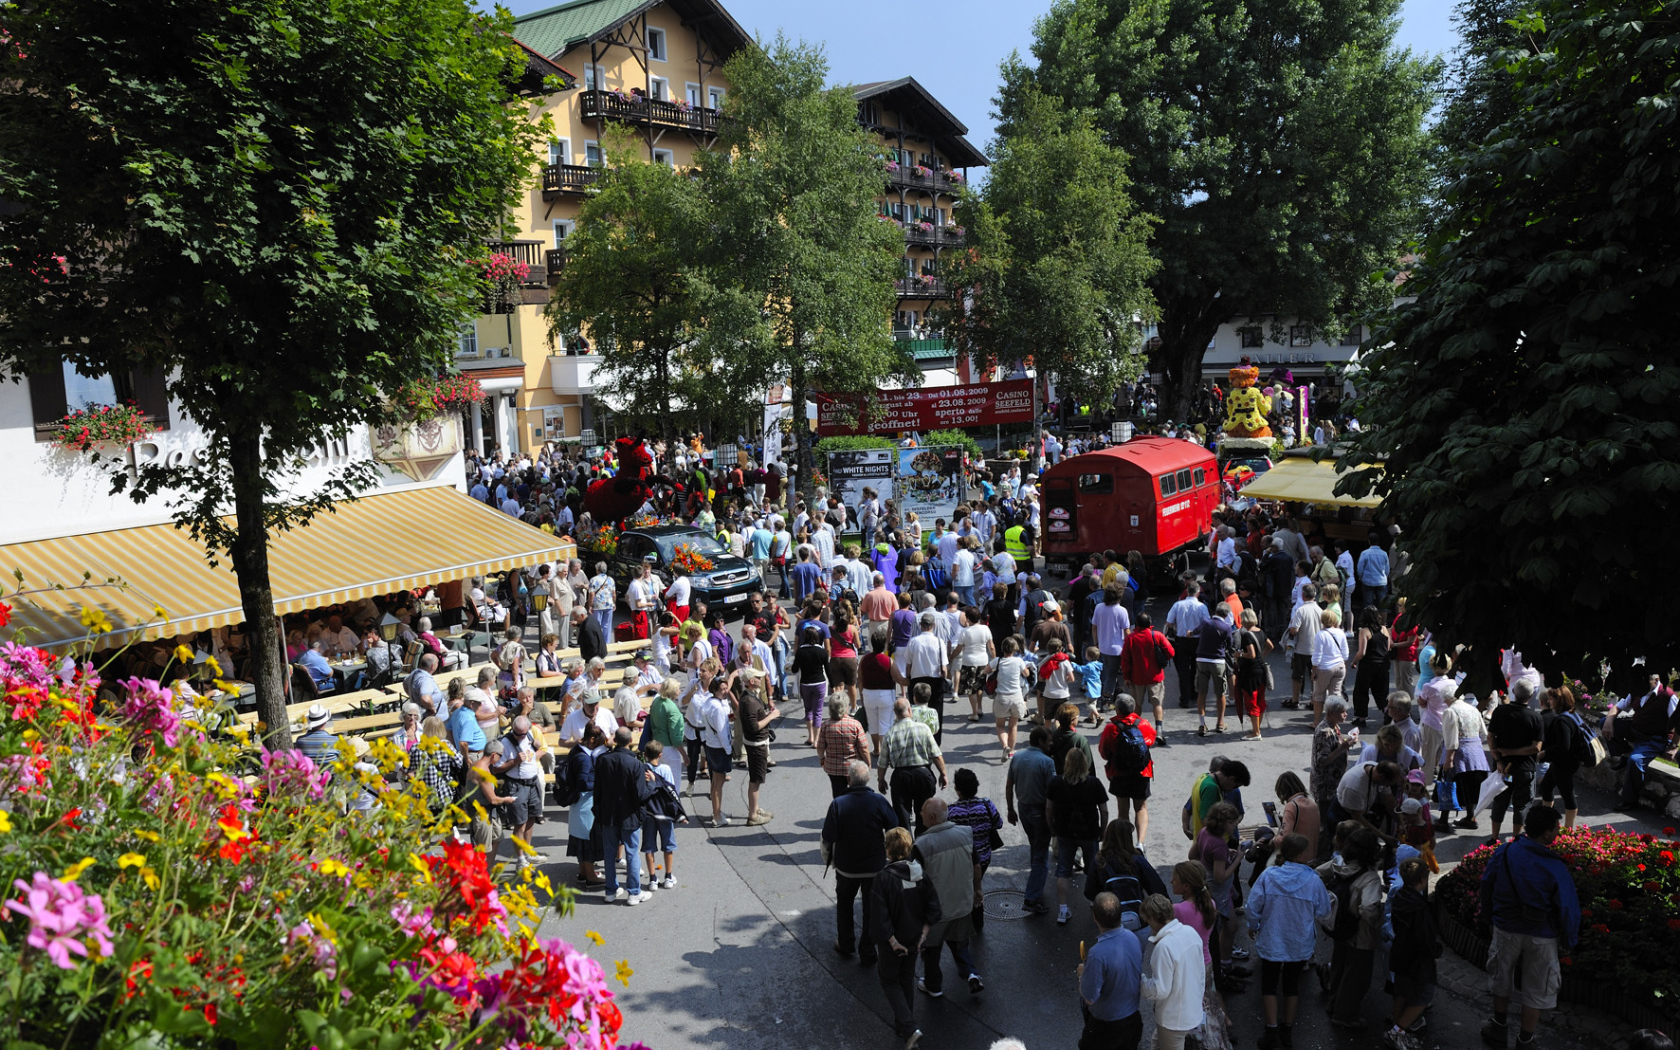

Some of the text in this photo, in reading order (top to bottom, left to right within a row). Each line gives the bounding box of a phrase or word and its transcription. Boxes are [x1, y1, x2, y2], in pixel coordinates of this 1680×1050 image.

[1240, 353, 1315, 364] AILER
[906, 391, 923, 400] 23.
[940, 387, 988, 398] 01.08.2009
[996, 390, 1029, 400] CASINO
[938, 398, 986, 408] 23.08.2009
[995, 399, 1031, 408] SEEFELD
[935, 408, 965, 418] aperto
[951, 415, 978, 424] 13.00!
[868, 418, 920, 432] geöffnet!
[842, 466, 864, 474] WHITE
[864, 465, 889, 473] NIGHTS
